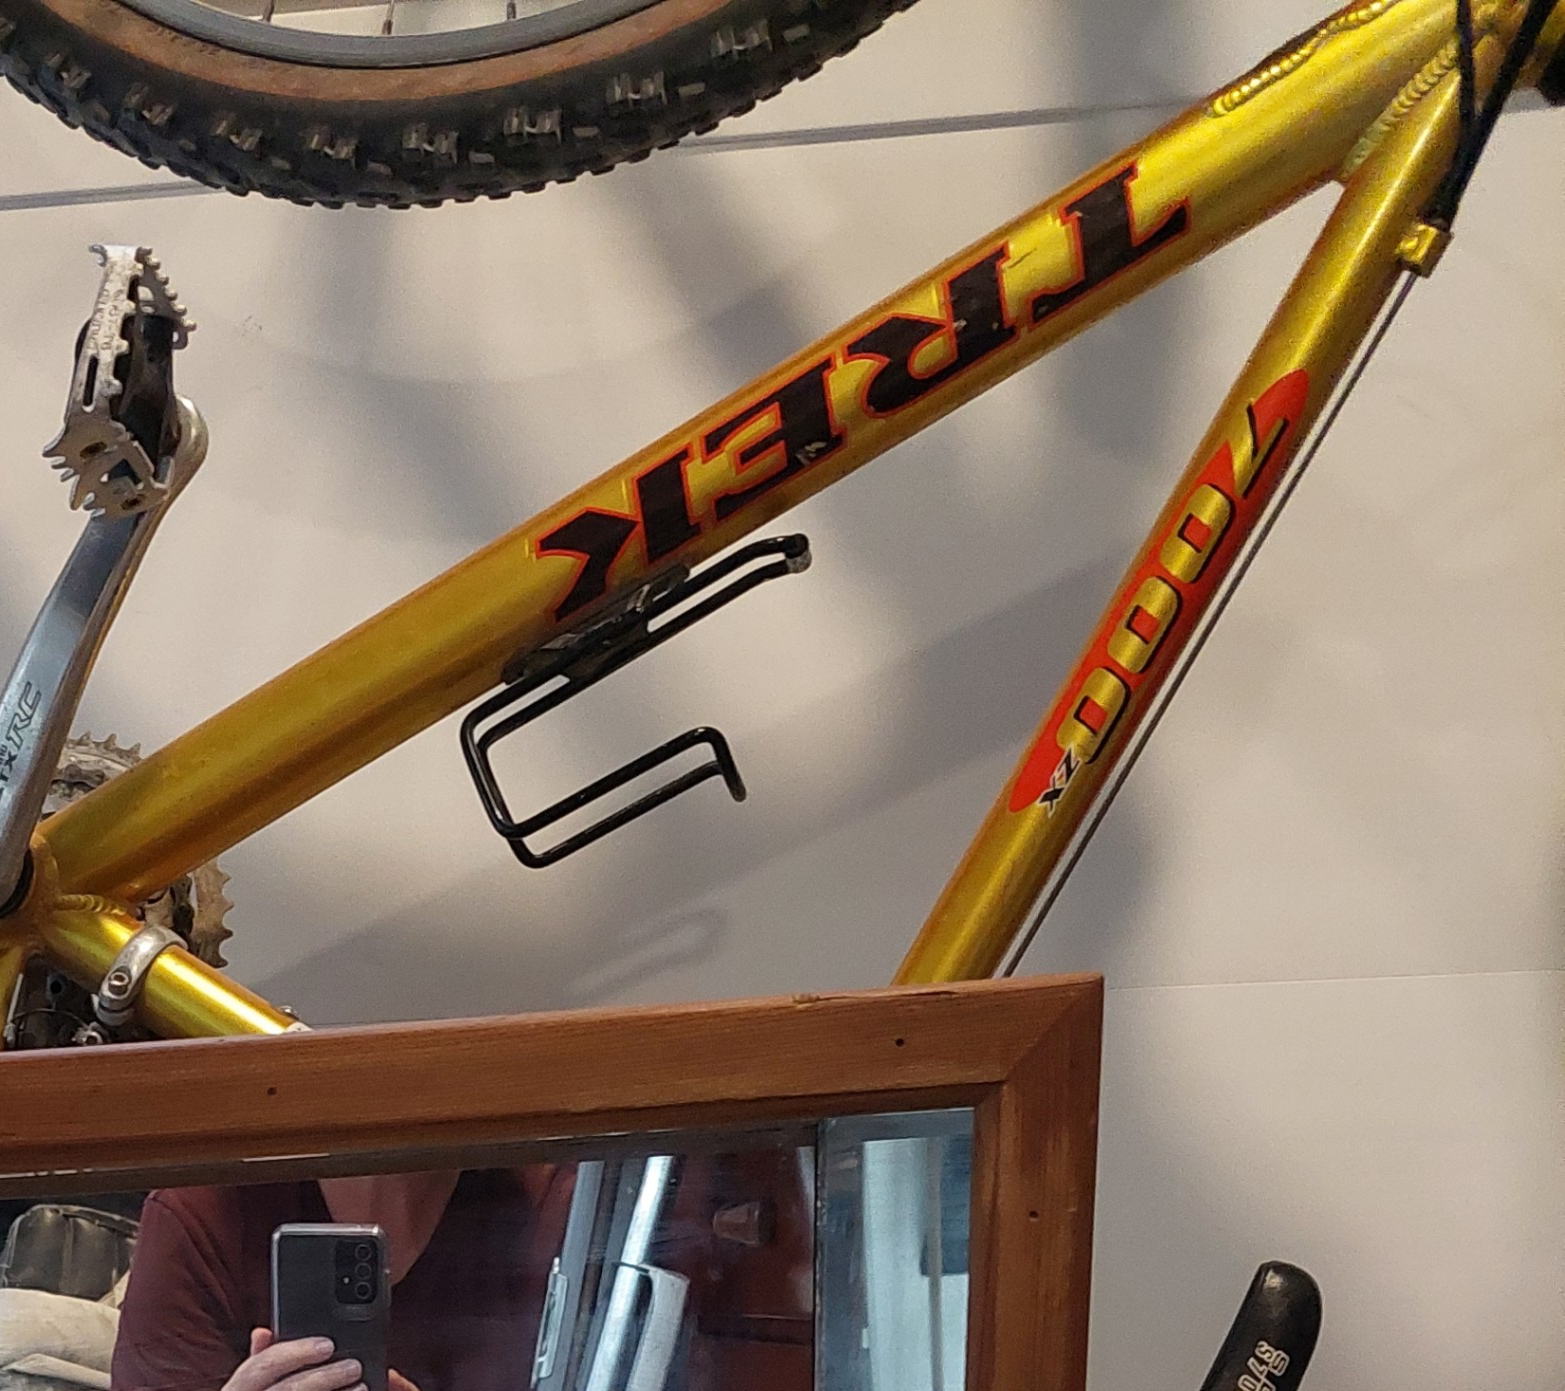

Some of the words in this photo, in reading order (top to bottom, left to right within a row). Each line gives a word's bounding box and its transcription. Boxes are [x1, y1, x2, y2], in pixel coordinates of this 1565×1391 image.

[535, 160, 1191, 623] TREK
[1055, 402, 1290, 765] 7000
[4, 680, 42, 752] RC
[1037, 743, 1082, 818] ZX
